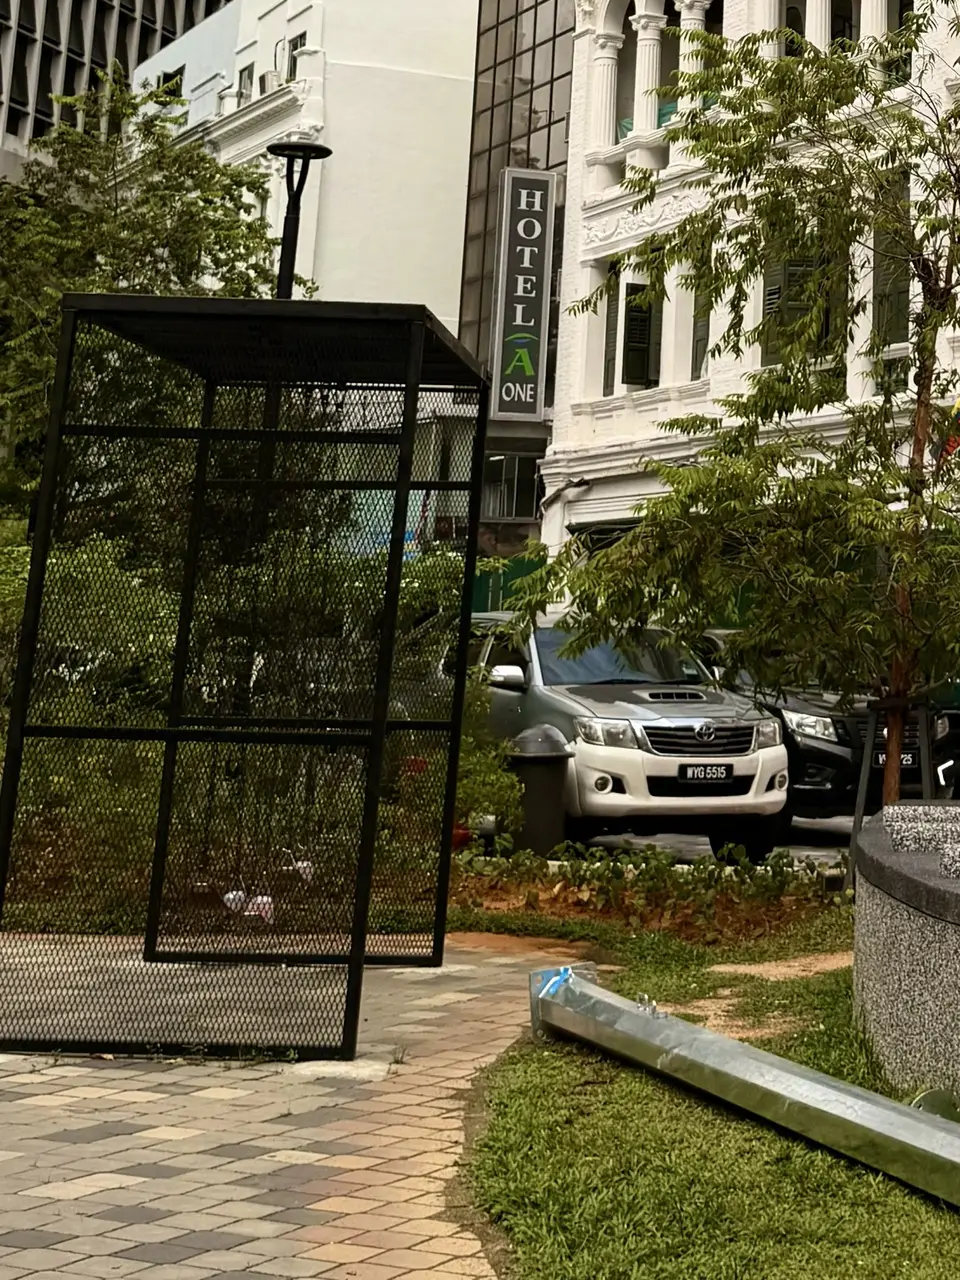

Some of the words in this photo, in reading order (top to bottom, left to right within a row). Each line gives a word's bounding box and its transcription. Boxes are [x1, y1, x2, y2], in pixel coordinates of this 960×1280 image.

[511, 188, 545, 327] HOTEL
[504, 347, 536, 377] A
[501, 382, 535, 403] ONE
[686, 766, 705, 779] WYG
[705, 766, 727, 779] 5515
